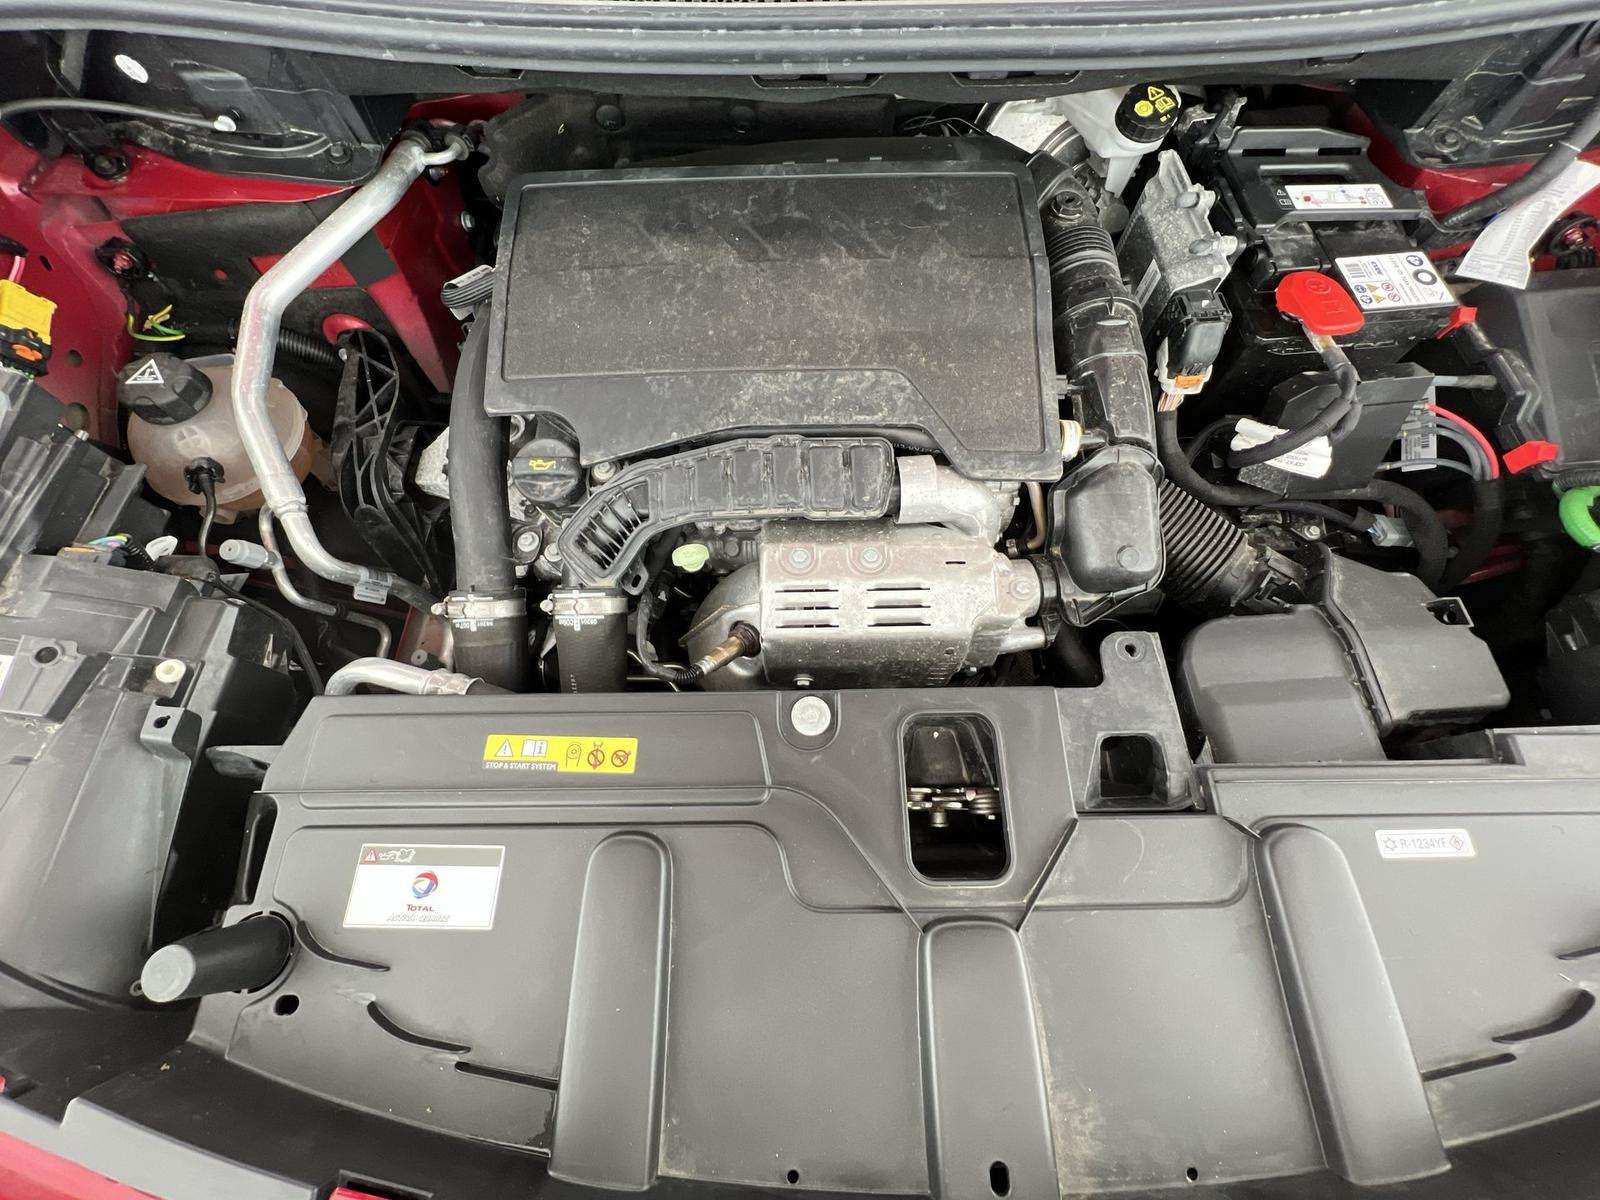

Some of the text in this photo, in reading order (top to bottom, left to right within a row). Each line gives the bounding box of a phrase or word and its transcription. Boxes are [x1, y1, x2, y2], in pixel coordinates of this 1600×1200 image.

[485, 761, 503, 769] STOP
[509, 762, 530, 770] START
[532, 763, 556, 771] SYSTEM
[406, 904, 434, 912] TOTAL
